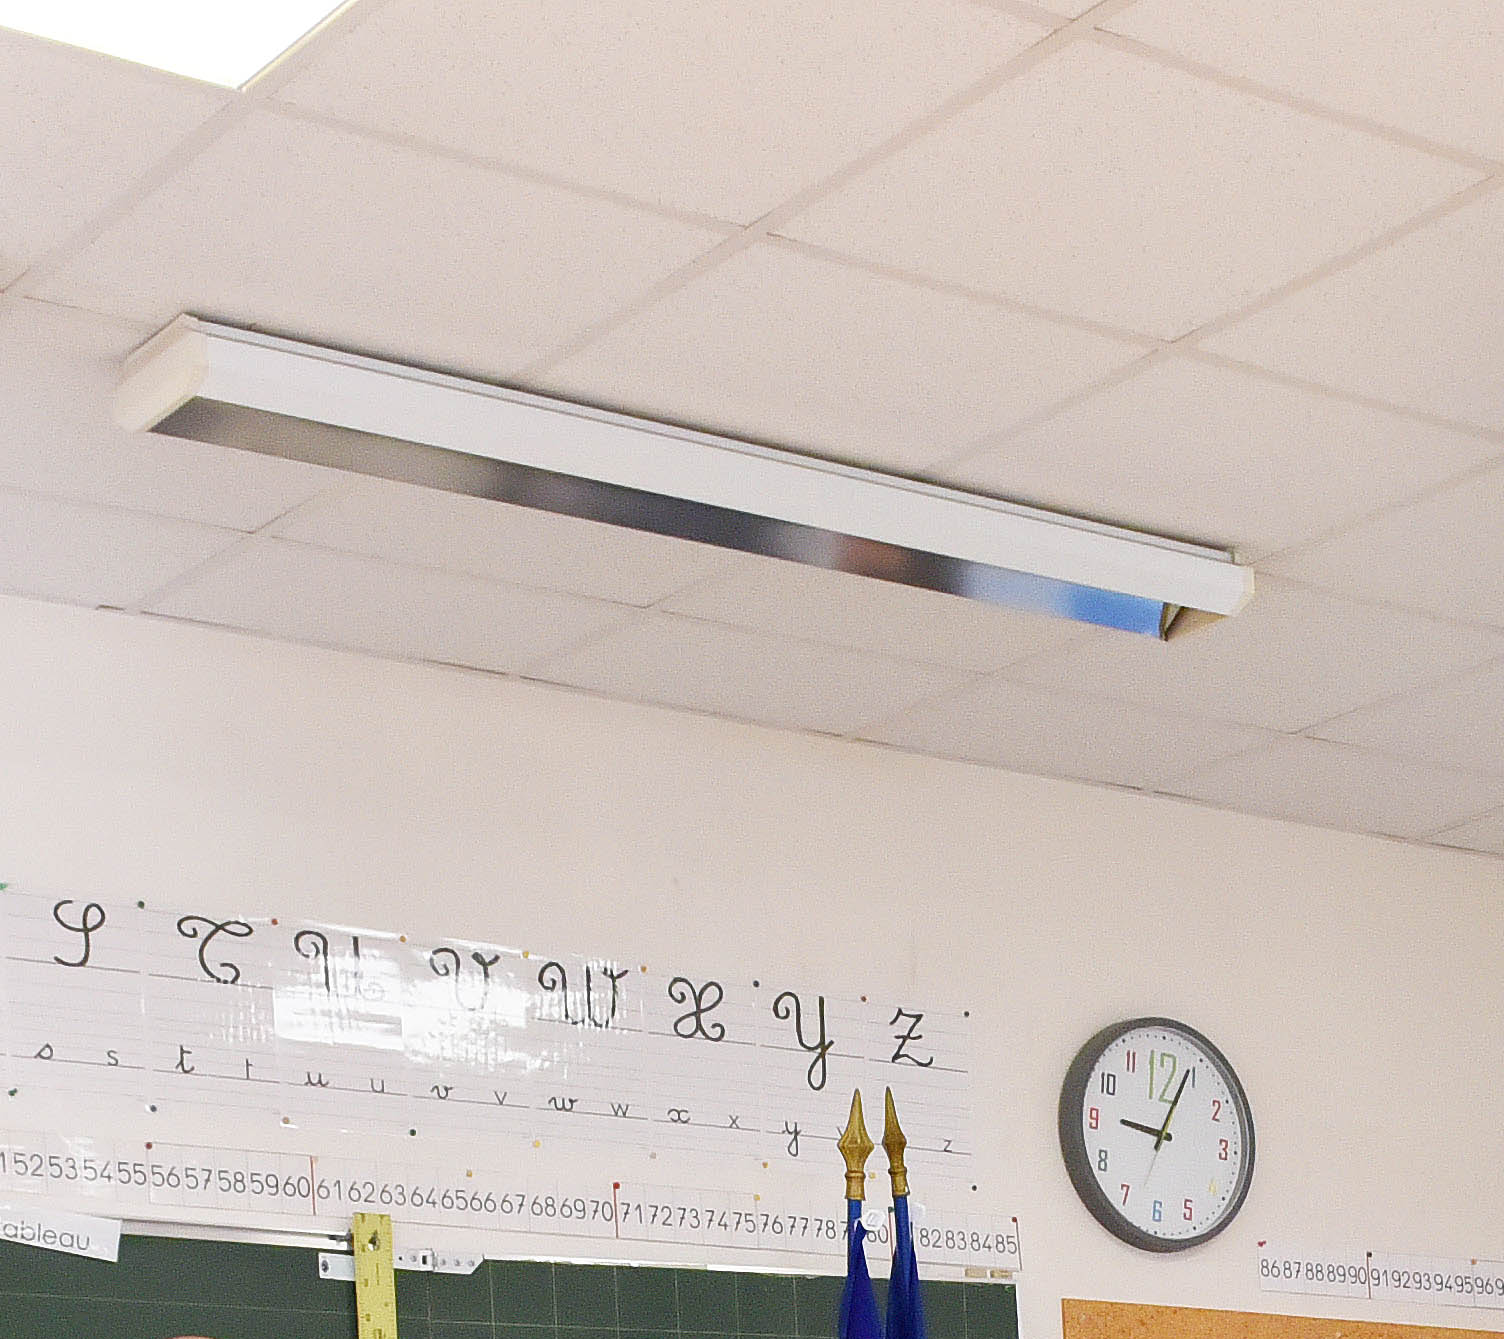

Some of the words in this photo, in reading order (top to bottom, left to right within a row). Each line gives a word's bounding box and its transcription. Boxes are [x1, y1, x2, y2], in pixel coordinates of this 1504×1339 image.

[54, 900, 105, 967] S
[177, 915, 253, 984] T
[668, 977, 725, 1042] X
[773, 992, 834, 1091] Y
[889, 1008, 933, 1067] Z
[1126, 1050, 1136, 1073] 11
[1100, 1071, 1116, 1096] 10
[1148, 1049, 1177, 1104] 12
[1191, 1066, 1196, 1089] 1
[304, 1072, 329, 1088] u
[370, 1078, 388, 1094] u
[430, 1085, 454, 1100] v
[493, 1091, 508, 1106] v
[548, 1097, 578, 1113] w
[610, 1103, 634, 1119] w
[667, 1109, 690, 1124] x
[726, 1115, 743, 1130] x
[779, 1121, 801, 1157] y
[940, 1139, 957, 1154] z
[1089, 1107, 1099, 1130] 9
[1212, 1100, 1221, 1122] 2
[1098, 1149, 1108, 1172] 8
[1218, 1139, 1229, 1161] 3
[14, 1152, 44, 1177] 52
[49, 1156, 78, 1180] 53
[84, 1159, 113, 1182] 54
[118, 1161, 147, 1185] 55
[151, 1165, 180, 1188] 56
[185, 1167, 212, 1190] 57
[218, 1170, 246, 1193] 58
[250, 1173, 279, 1196] 59
[282, 1176, 310, 1198] 60
[317, 1179, 341, 1200] 61
[348, 1181, 375, 1203] 62
[380, 1184, 406, 1206] 63
[411, 1186, 437, 1208] 64
[441, 1189, 468, 1211] 65
[470, 1191, 497, 1213] 66
[500, 1194, 525, 1214] 67
[531, 1196, 556, 1217] 68
[560, 1198, 586, 1219] 69
[590, 1200, 613, 1222] 70
[620, 1202, 642, 1224] 71
[649, 1205, 673, 1226] 72
[677, 1207, 700, 1229] 73
[705, 1210, 728, 1231] 74
[733, 1212, 756, 1233] 75
[760, 1213, 783, 1234] 76
[788, 1216, 808, 1237] 77
[814, 1218, 836, 1239] 78
[920, 1228, 942, 1248] 82
[946, 1230, 967, 1250] 83
[970, 1232, 992, 1252] 84
[995, 1234, 1017, 1254] 85
[1120, 1184, 1130, 1206] 7
[1152, 1200, 1163, 1222] 6
[1183, 1199, 1193, 1221] 5
[1261, 1259, 1280, 1278] 86
[1283, 1261, 1301, 1279] 87
[1305, 1262, 1324, 1281] 88
[1327, 1264, 1346, 1283] 89
[1348, 1267, 1367, 1284] 90
[1371, 1268, 1388, 1286] 91
[1391, 1270, 1411, 1289] 92
[1412, 1272, 1432, 1290] 93
[1434, 1274, 1453, 1292] 94
[1454, 1275, 1474, 1294] 95
[1474, 1277, 1494, 1295] 96
